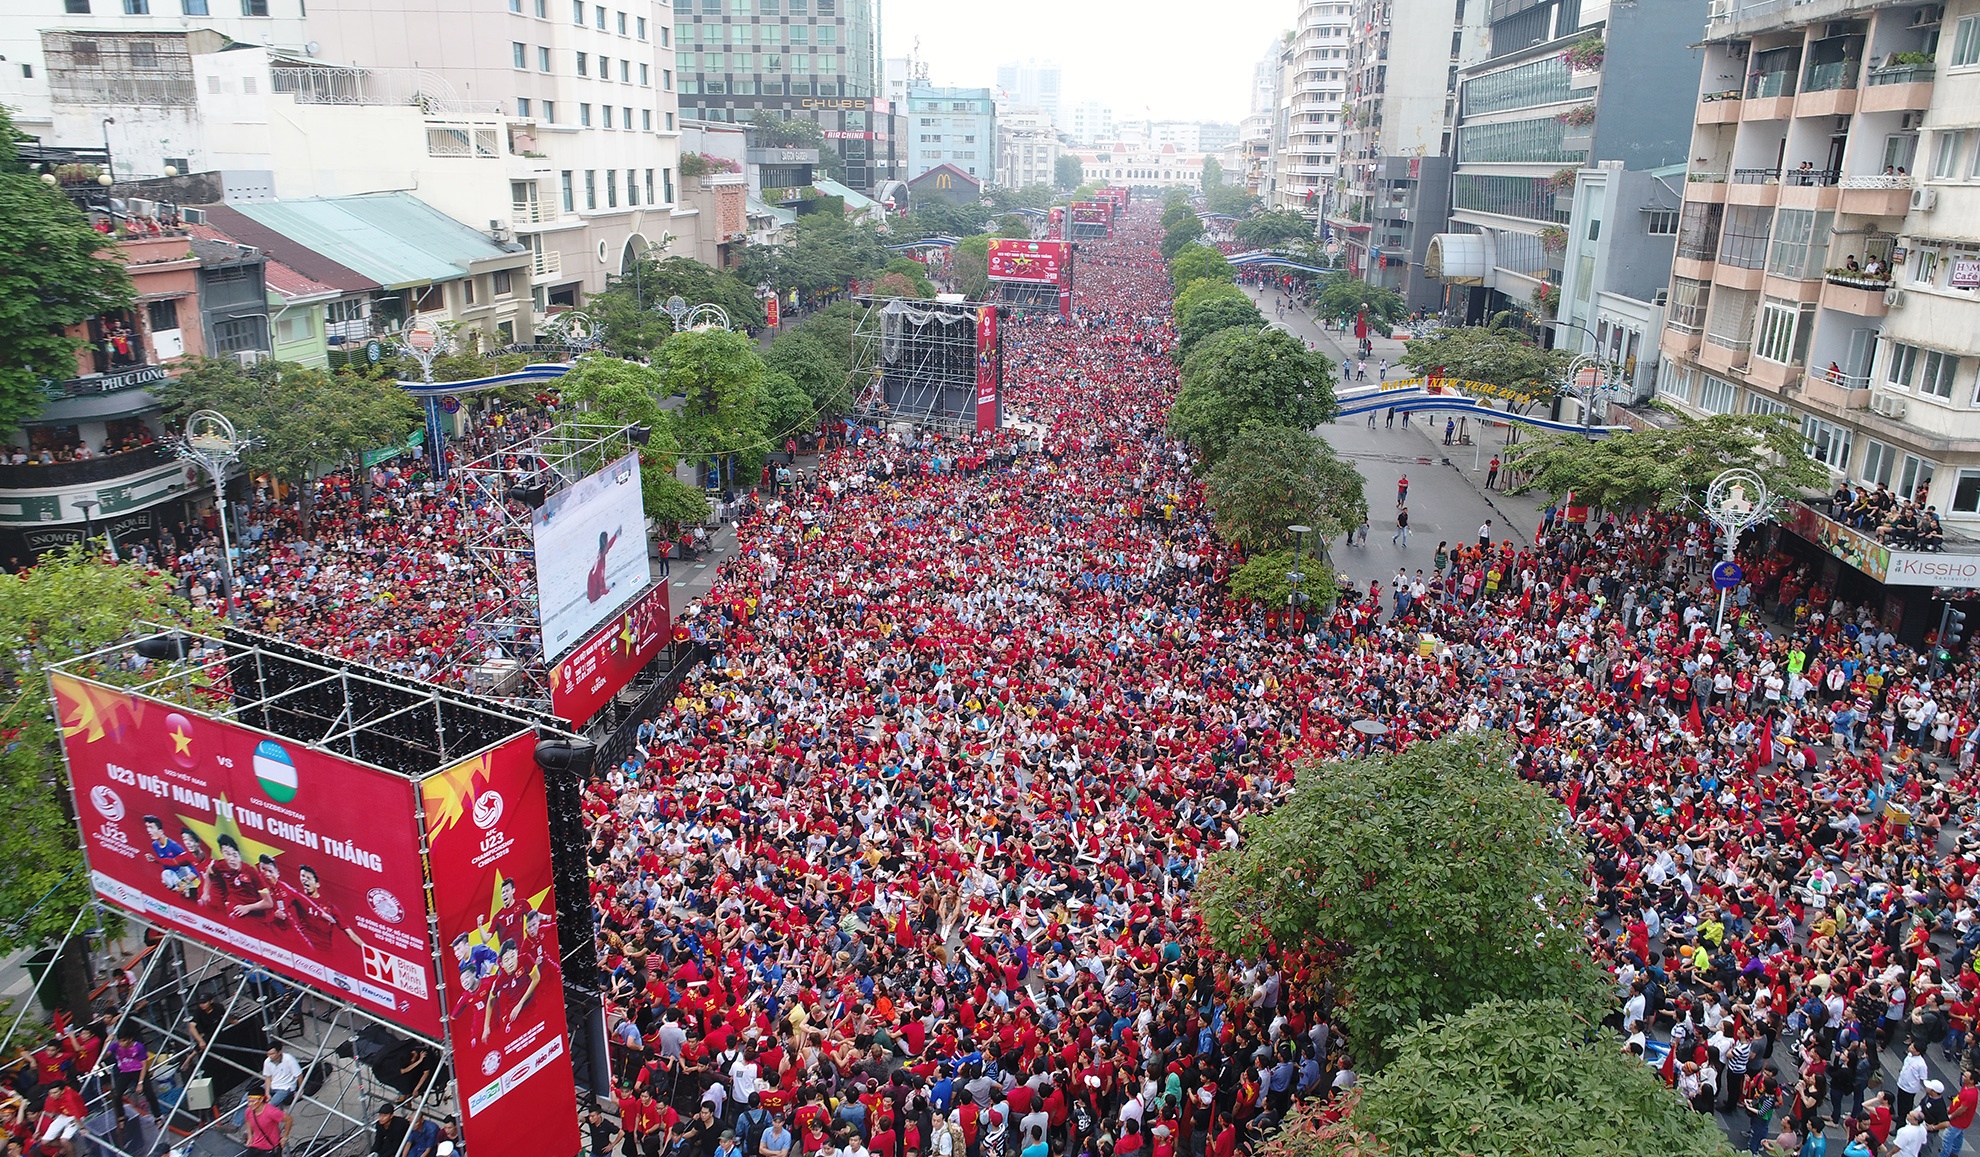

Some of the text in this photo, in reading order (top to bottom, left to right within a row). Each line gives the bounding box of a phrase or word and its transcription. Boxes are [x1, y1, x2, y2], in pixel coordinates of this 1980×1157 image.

[801, 99, 866, 108] CHUBB
[1381, 378, 1531, 404] HAPPY NEW YEAR 2018
[106, 763, 383, 873] U23 VIỆT NAM TỰ TIN CHIẾN THẮNG
[264, 802, 306, 820] UZBEKISTAN
[100, 824, 128, 844] U23
[486, 828, 497, 837] AFC
[480, 832, 504, 852] U23
[471, 838, 514, 864] CHAMPIONSHIP
[478, 854, 498, 868] CHINA
[506, 914, 514, 926] 17
[398, 970, 422, 986] Minh
[400, 982, 427, 998] Media
